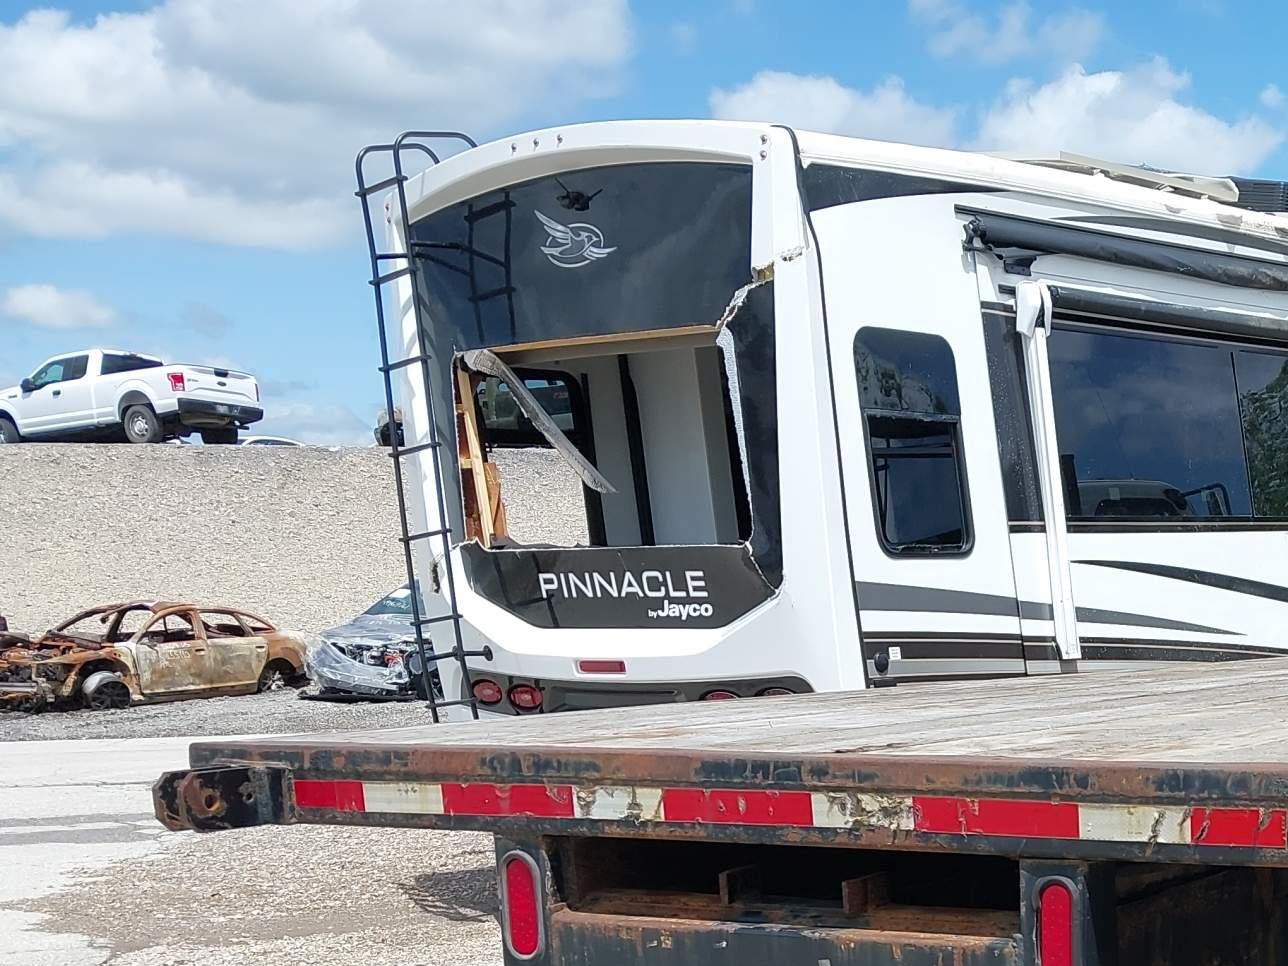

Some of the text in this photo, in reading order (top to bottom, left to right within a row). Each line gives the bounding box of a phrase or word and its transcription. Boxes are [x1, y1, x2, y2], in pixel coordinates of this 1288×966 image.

[538, 571, 708, 598] PINNACLE
[648, 600, 713, 620] by Jayco
